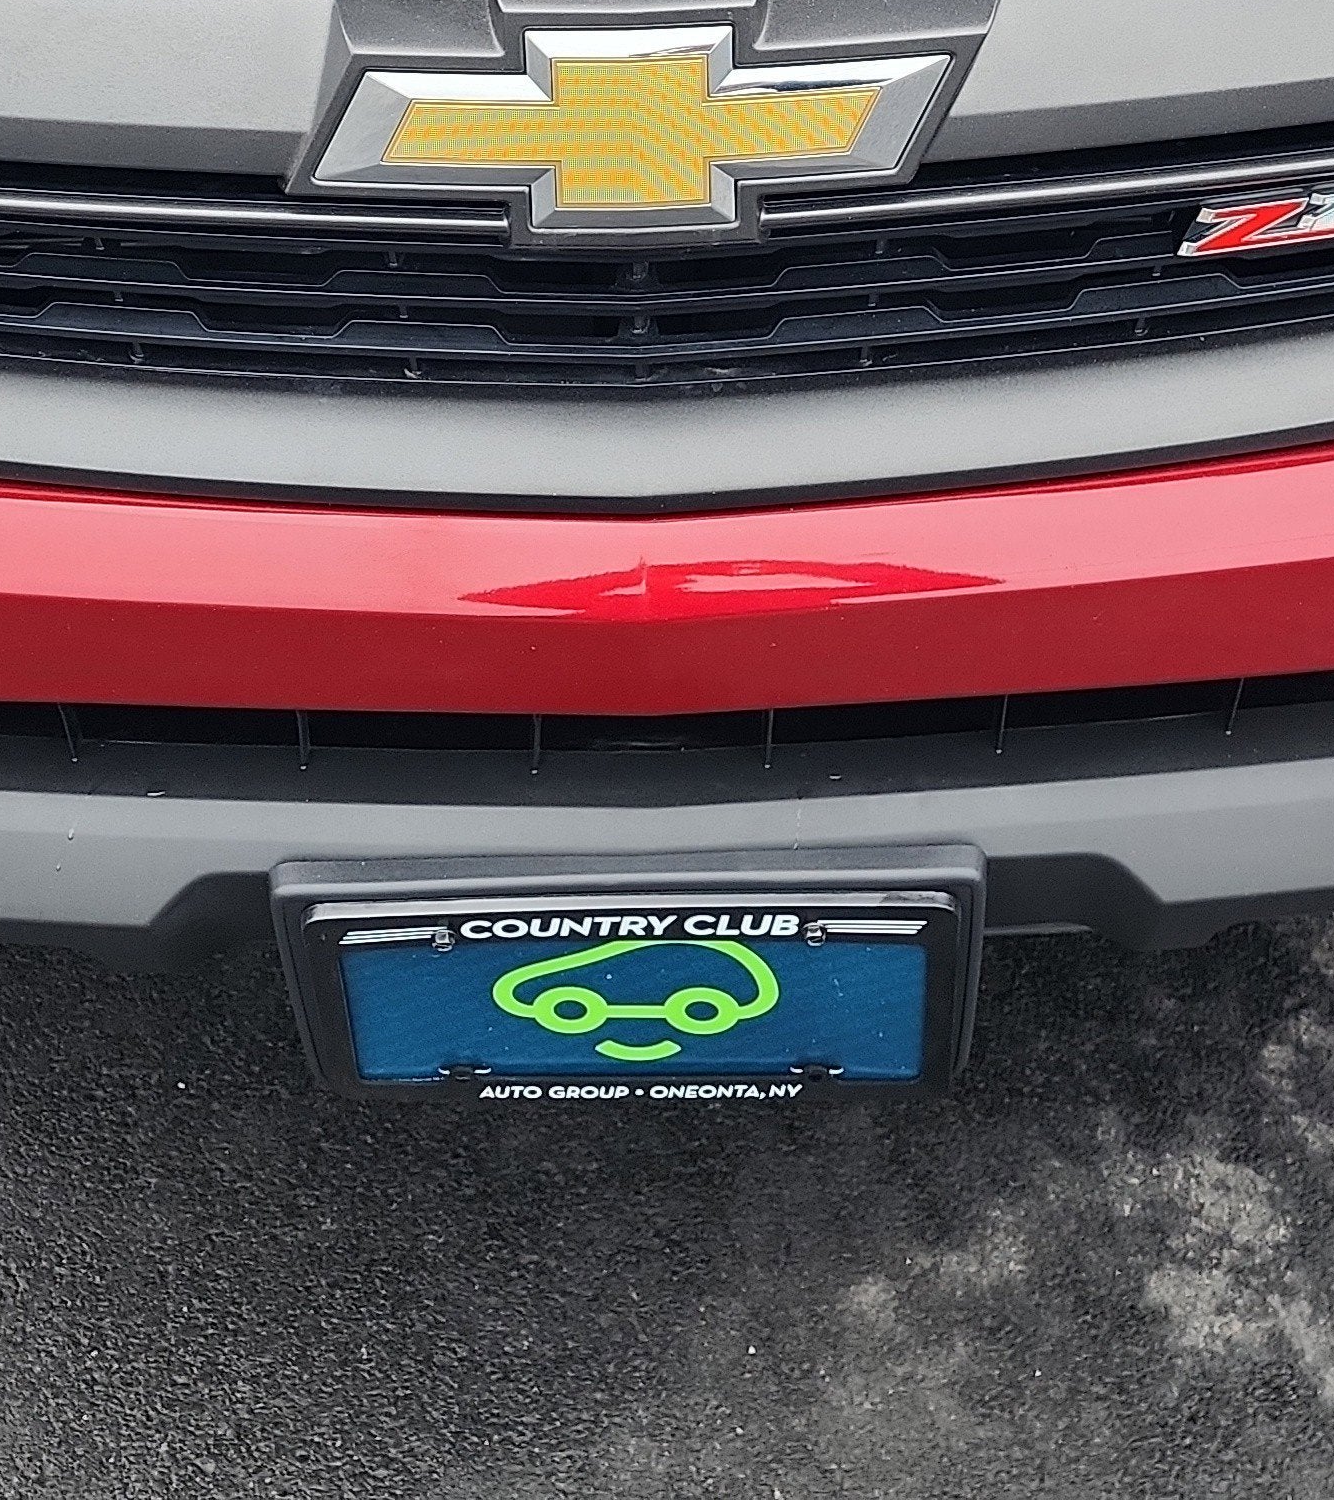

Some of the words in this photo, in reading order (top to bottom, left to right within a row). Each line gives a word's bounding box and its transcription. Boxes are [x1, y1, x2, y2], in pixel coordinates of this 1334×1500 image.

[460, 915, 678, 939] COUNTRY
[683, 914, 800, 936] CLUB
[479, 1085, 542, 1099] AUTO
[548, 1085, 630, 1099] GROUP
